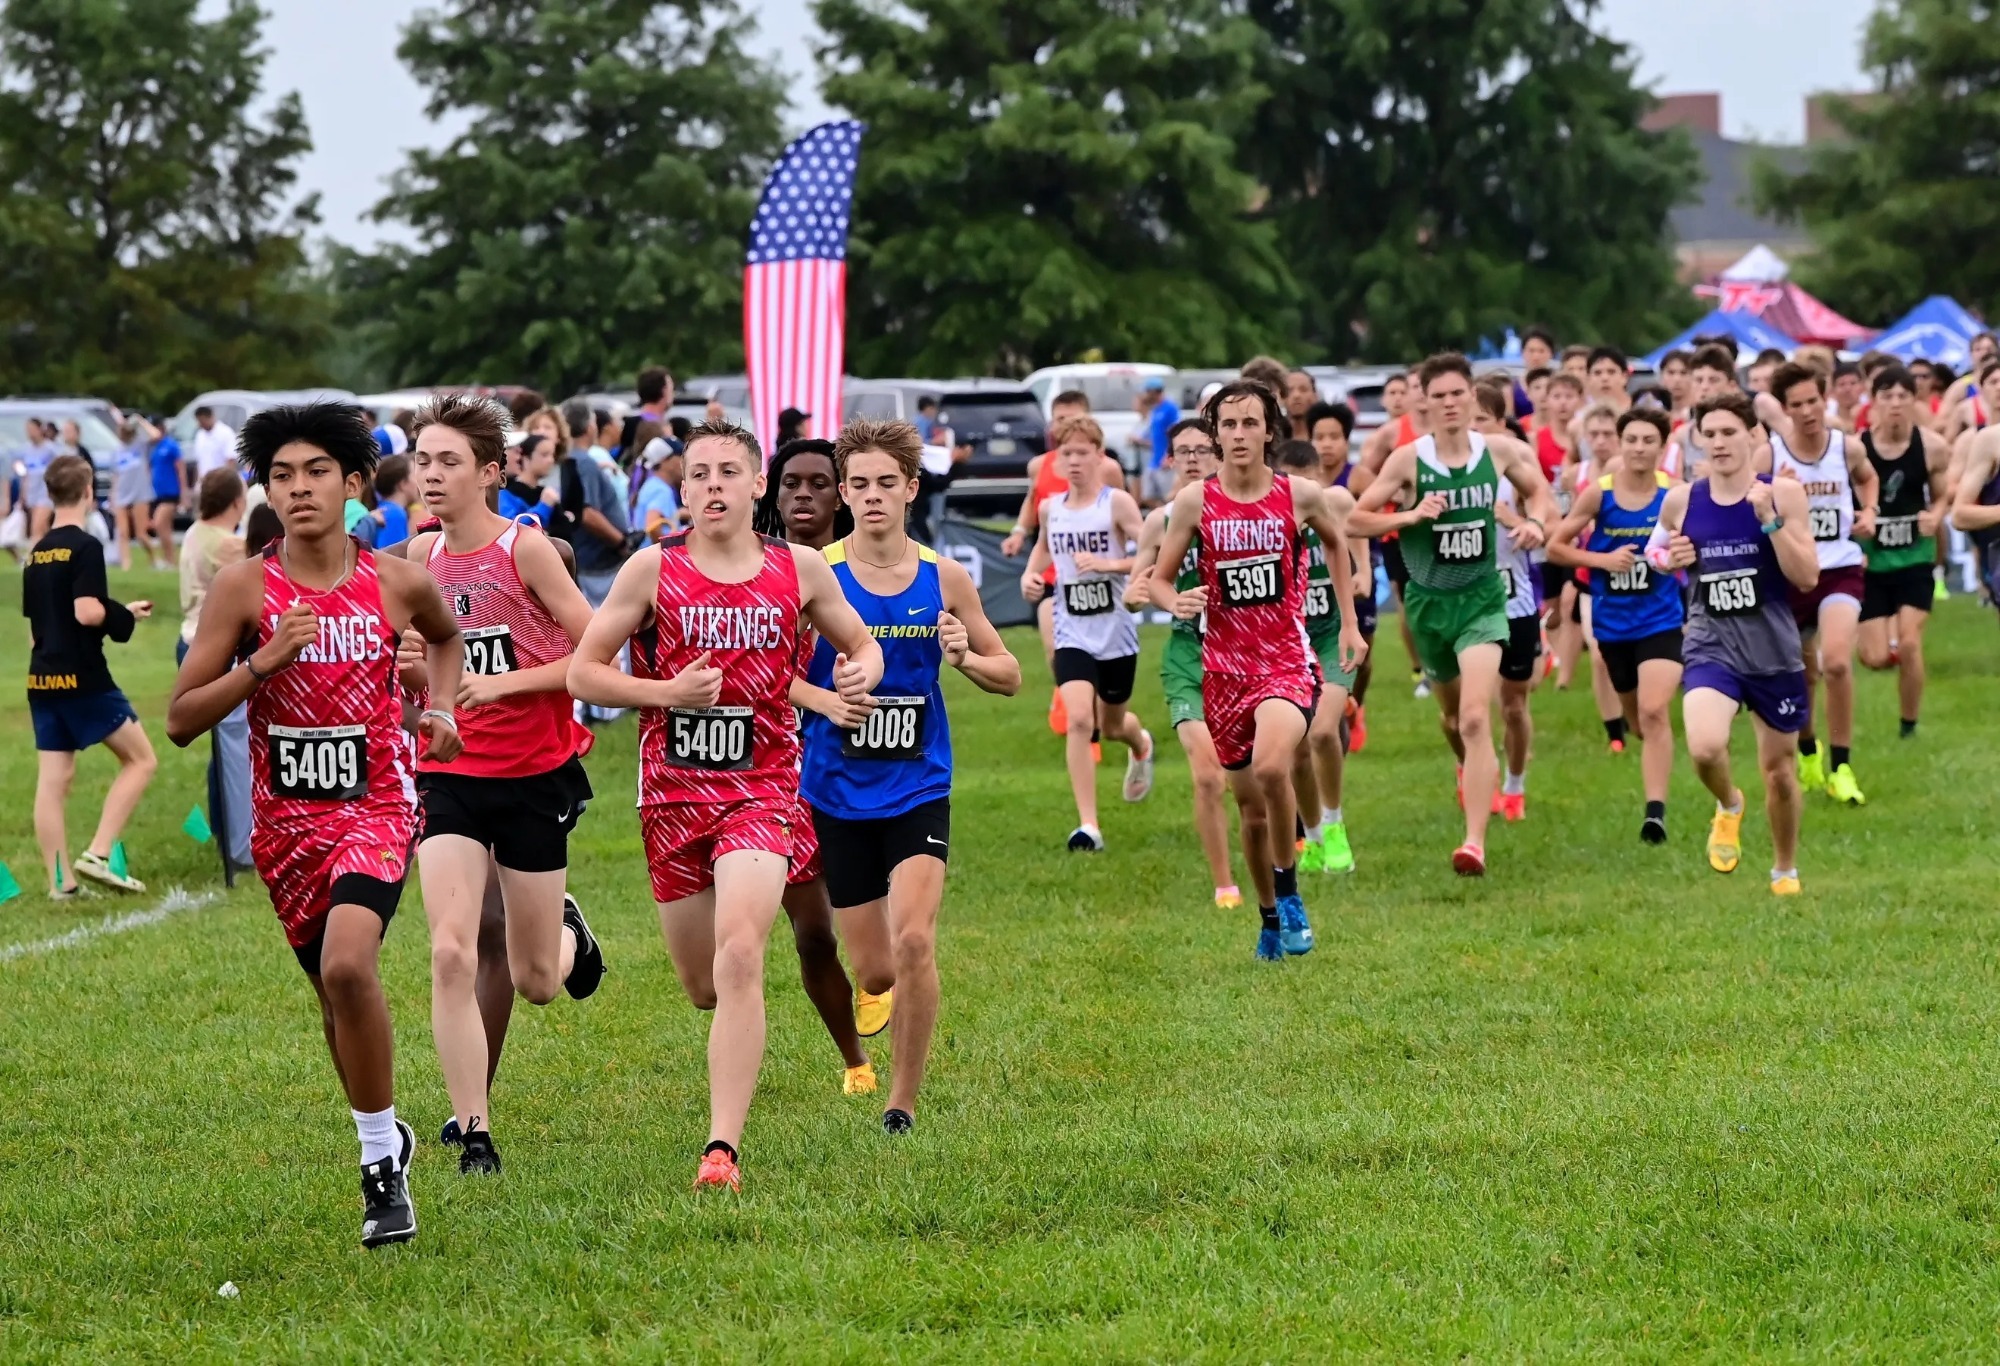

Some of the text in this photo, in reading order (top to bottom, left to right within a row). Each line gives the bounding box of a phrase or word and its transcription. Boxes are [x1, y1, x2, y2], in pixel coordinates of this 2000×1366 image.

[1424, 482, 1494, 511] LINA
[1052, 531, 1109, 554] STANGS
[1210, 518, 1285, 552] VIKINGS
[1439, 528, 1482, 559] 4460
[1069, 582, 1109, 611] 4960
[1225, 563, 1276, 601] 5397
[1708, 576, 1756, 612] 4639
[1302, 586, 1330, 617] 63
[269, 613, 382, 663] INGS
[679, 605, 783, 650] VIKINGS
[675, 716, 745, 762] 5400
[279, 739, 358, 790] 5409
